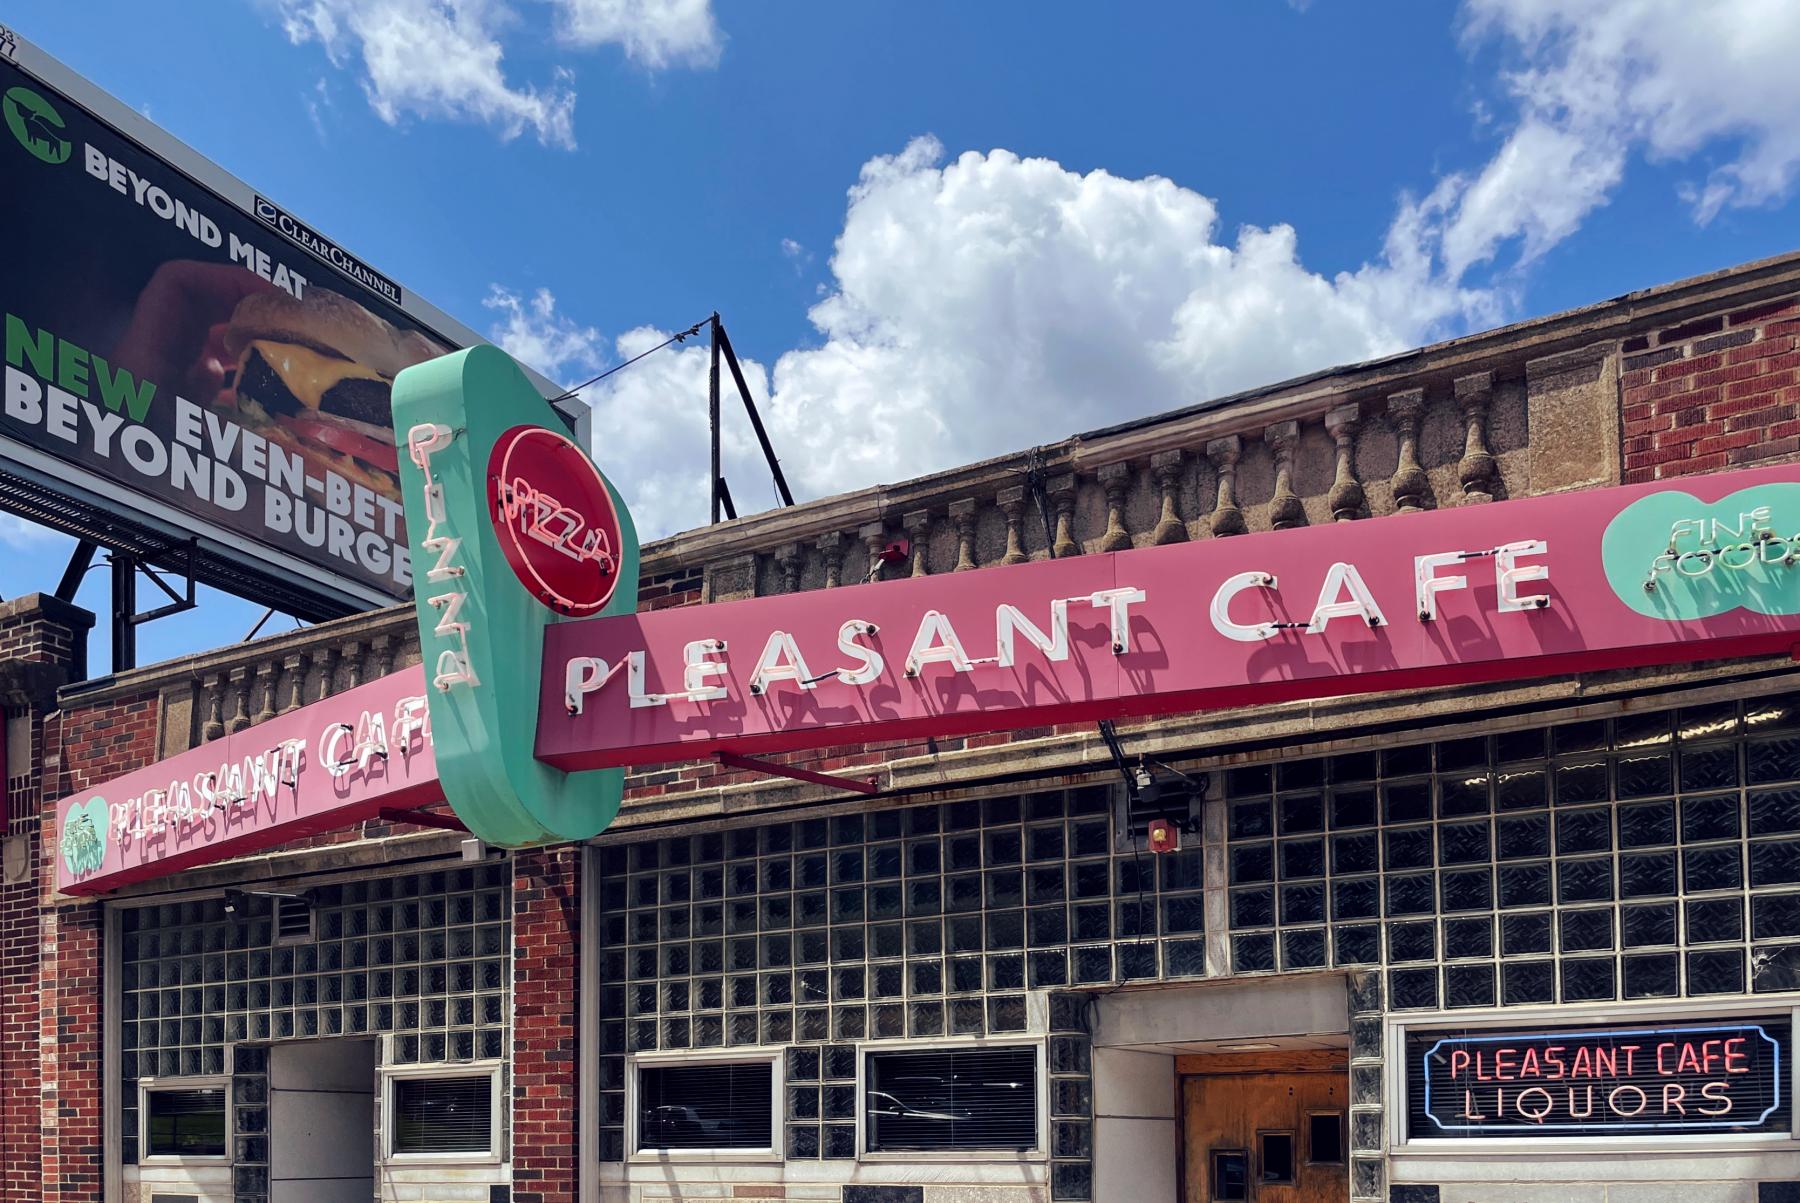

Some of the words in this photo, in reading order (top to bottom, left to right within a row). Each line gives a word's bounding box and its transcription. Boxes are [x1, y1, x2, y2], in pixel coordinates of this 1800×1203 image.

[85, 142, 223, 249] BEYOND
[229, 232, 308, 301] MEAT
[5, 313, 157, 423] NEW
[4, 365, 248, 513] BEYOND
[408, 422, 481, 688] PIZZA
[497, 476, 616, 577] PIZZA
[1643, 531, 1800, 592] FOOD
[1669, 506, 1773, 554] FINE
[565, 586, 1147, 715] PLEASANT
[1209, 539, 1551, 642] CAFE
[108, 738, 307, 846] PLEASANT
[319, 694, 434, 777] CAF
[1451, 1045, 1641, 1081] PLEASANT
[1656, 1037, 1750, 1075] CAFE
[1464, 1082, 1733, 1125] LIQUORS
